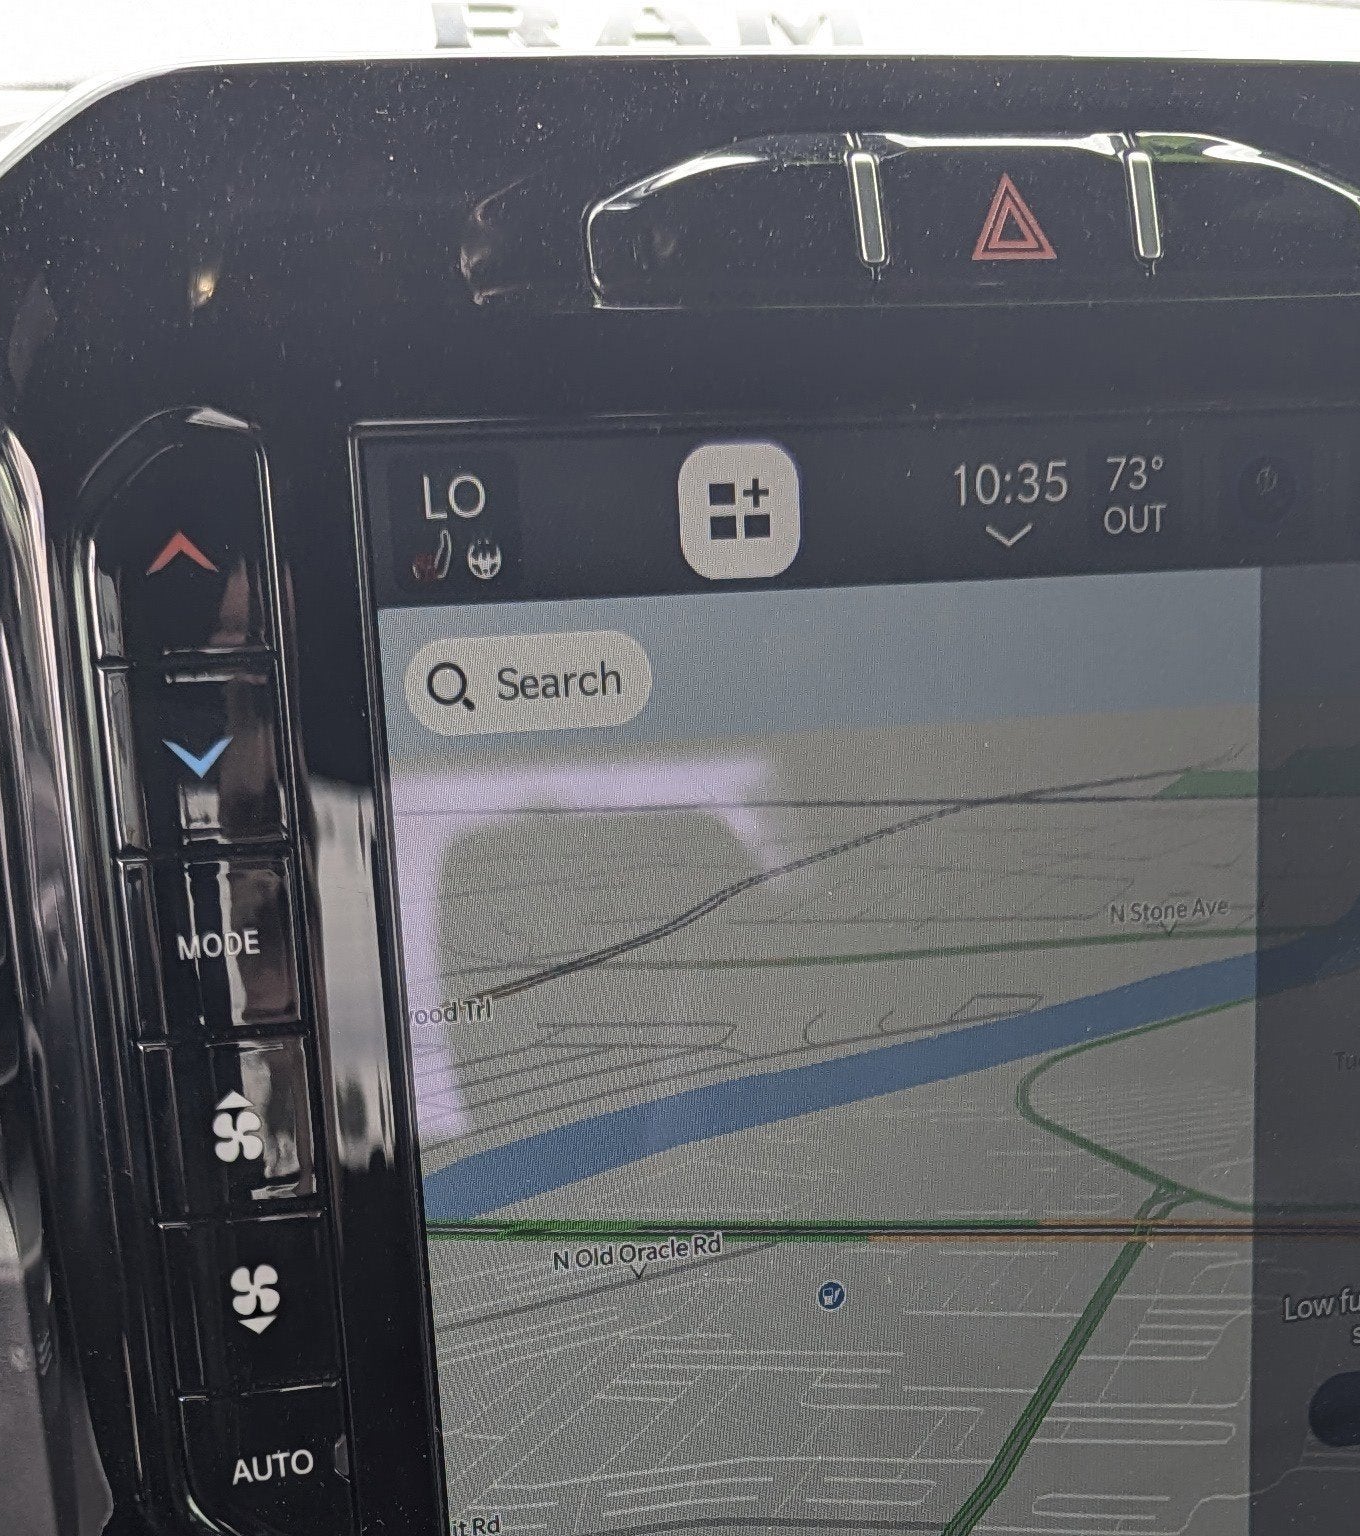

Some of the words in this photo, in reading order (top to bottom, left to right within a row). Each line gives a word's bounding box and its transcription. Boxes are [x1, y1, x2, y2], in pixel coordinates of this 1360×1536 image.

[433, 2, 864, 48] RAM
[953, 458, 1070, 508] 10:35
[1104, 455, 1166, 493] 73°
[421, 473, 487, 520] LO
[1103, 502, 1167, 535] OUT
[496, 660, 623, 702] Search
[1109, 904, 1125, 923] N
[1130, 900, 1186, 922] Stone
[1190, 897, 1229, 918] Ave
[177, 928, 262, 961] MODE
[553, 1252, 570, 1272] N
[575, 1245, 614, 1268] Old
[619, 1239, 689, 1265] Oracle
[694, 1234, 723, 1256] Rd
[1284, 1296, 1335, 1322] Low
[232, 1448, 315, 1485] AUTO
[472, 1515, 501, 1536] Rd
